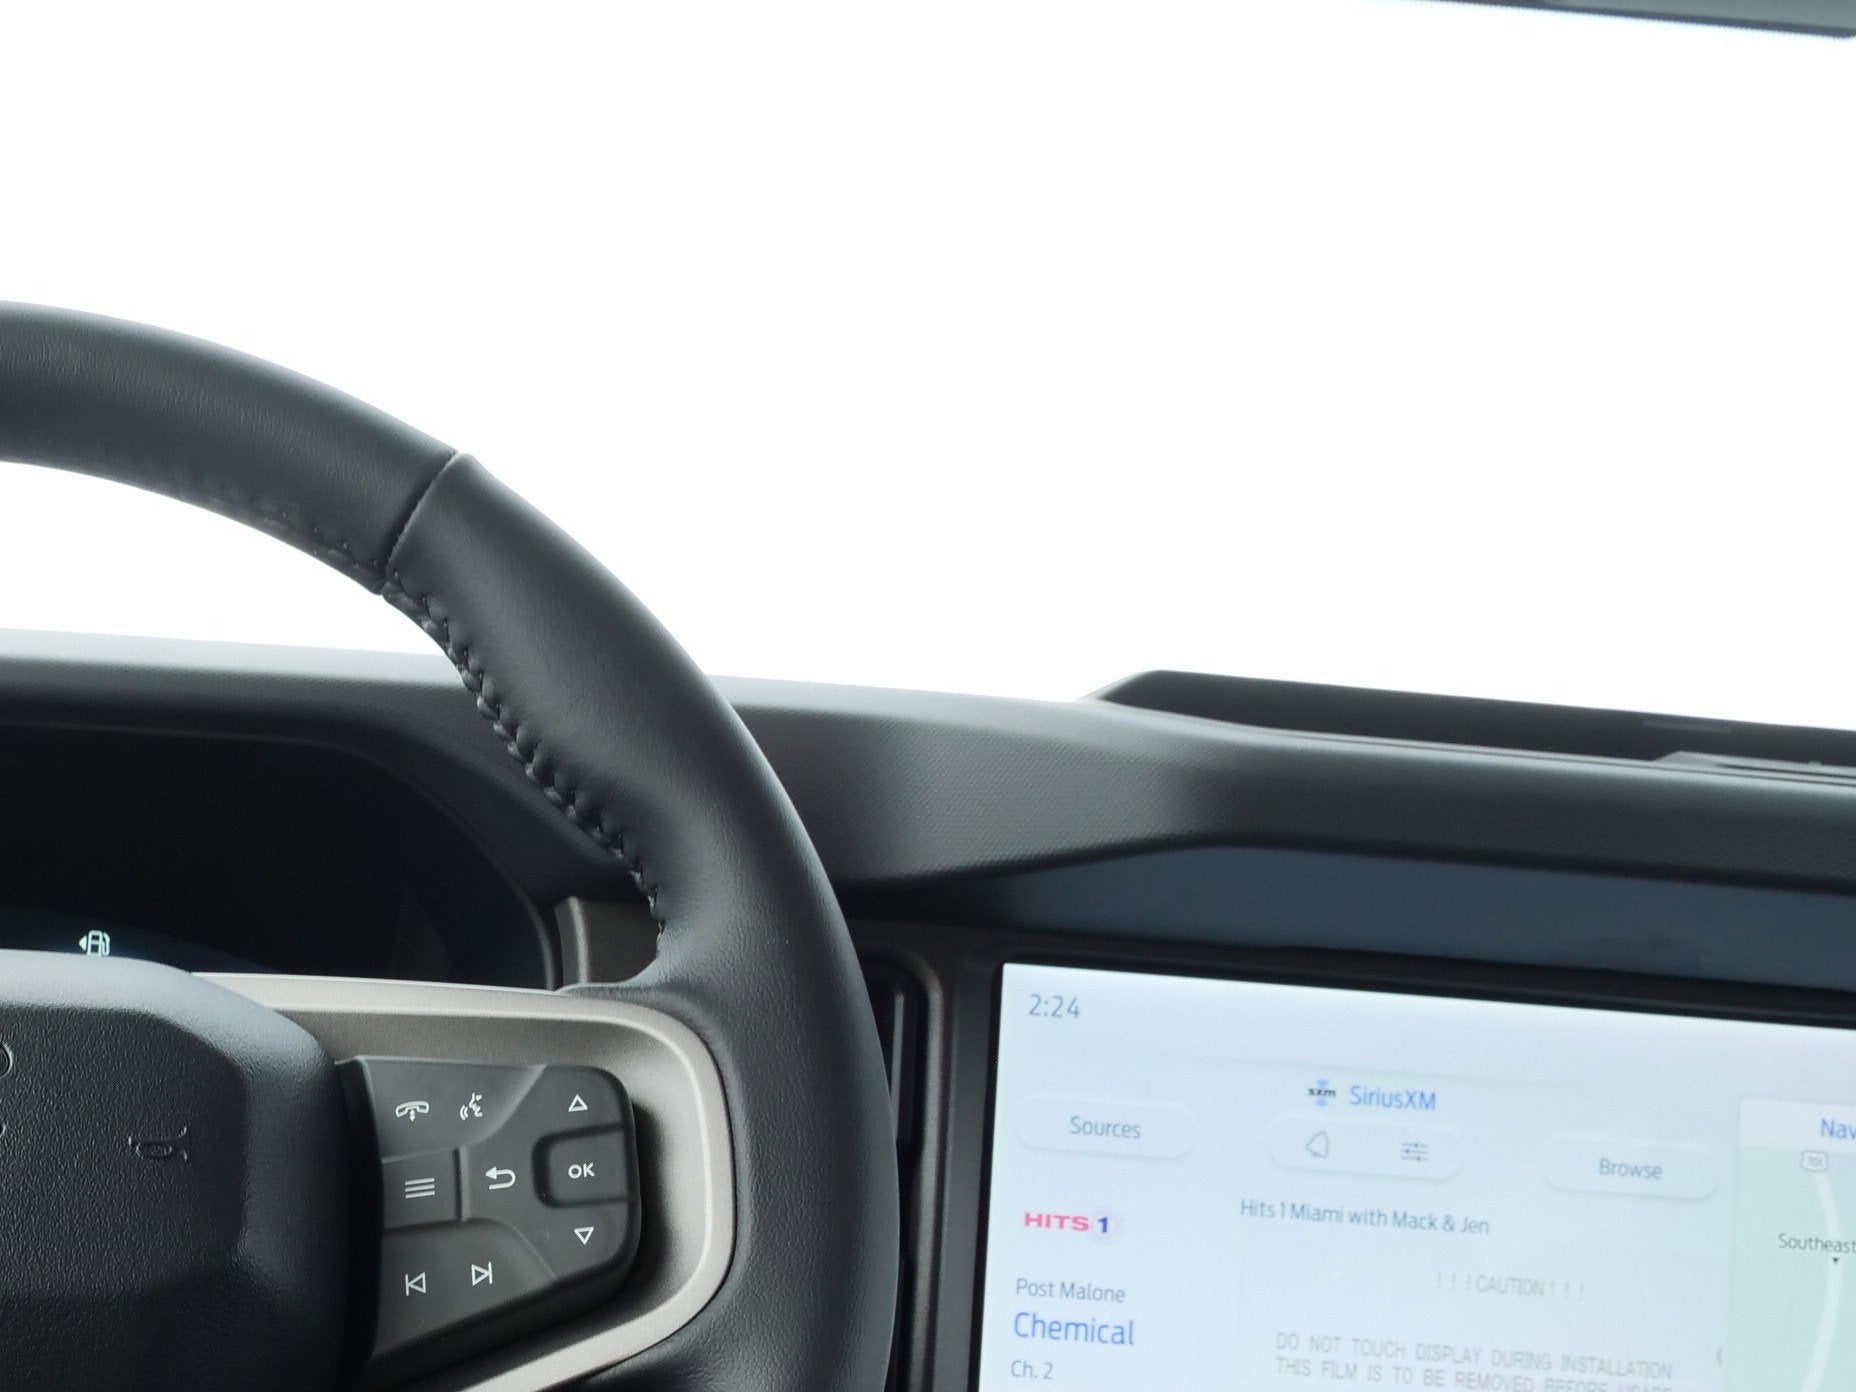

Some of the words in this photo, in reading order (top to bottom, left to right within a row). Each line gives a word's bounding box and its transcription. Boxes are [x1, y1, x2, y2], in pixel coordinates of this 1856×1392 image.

[1028, 993, 1082, 1020] 2:24
[1349, 1084, 1437, 1112] SiriusXM
[1069, 1115, 1142, 1141] Sources
[568, 1162, 595, 1180] OK
[1598, 1157, 1664, 1180] Browse
[1023, 1210, 1090, 1233] HITS
[1096, 1215, 1110, 1235] 1
[1240, 1199, 1275, 1220] Hits
[1289, 1203, 1344, 1223] Miami
[1348, 1207, 1388, 1227] with
[1392, 1210, 1437, 1231] Mack
[1442, 1214, 1456, 1232] &
[1459, 1216, 1490, 1235] Jen
[1015, 1278, 1055, 1299] Post
[1059, 1281, 1126, 1304] Malone
[1013, 1311, 1136, 1346] Chemical
[1276, 1332, 1299, 1350] DO
[1308, 1334, 1343, 1353] NOT
[1352, 1337, 1406, 1359] TOUCH
[1415, 1343, 1481, 1366] DISPLAY
[1490, 1349, 1553, 1371] DURING
[1560, 1354, 1673, 1380] INSTALLATION
[1010, 1359, 1039, 1379] Ch.
[1042, 1362, 1054, 1380] 2
[1276, 1356, 1311, 1377] THIS
[1321, 1360, 1358, 1381] FILM
[1366, 1364, 1383, 1382] IS
[1392, 1366, 1415, 1384] TO
[1423, 1368, 1445, 1388] BE
